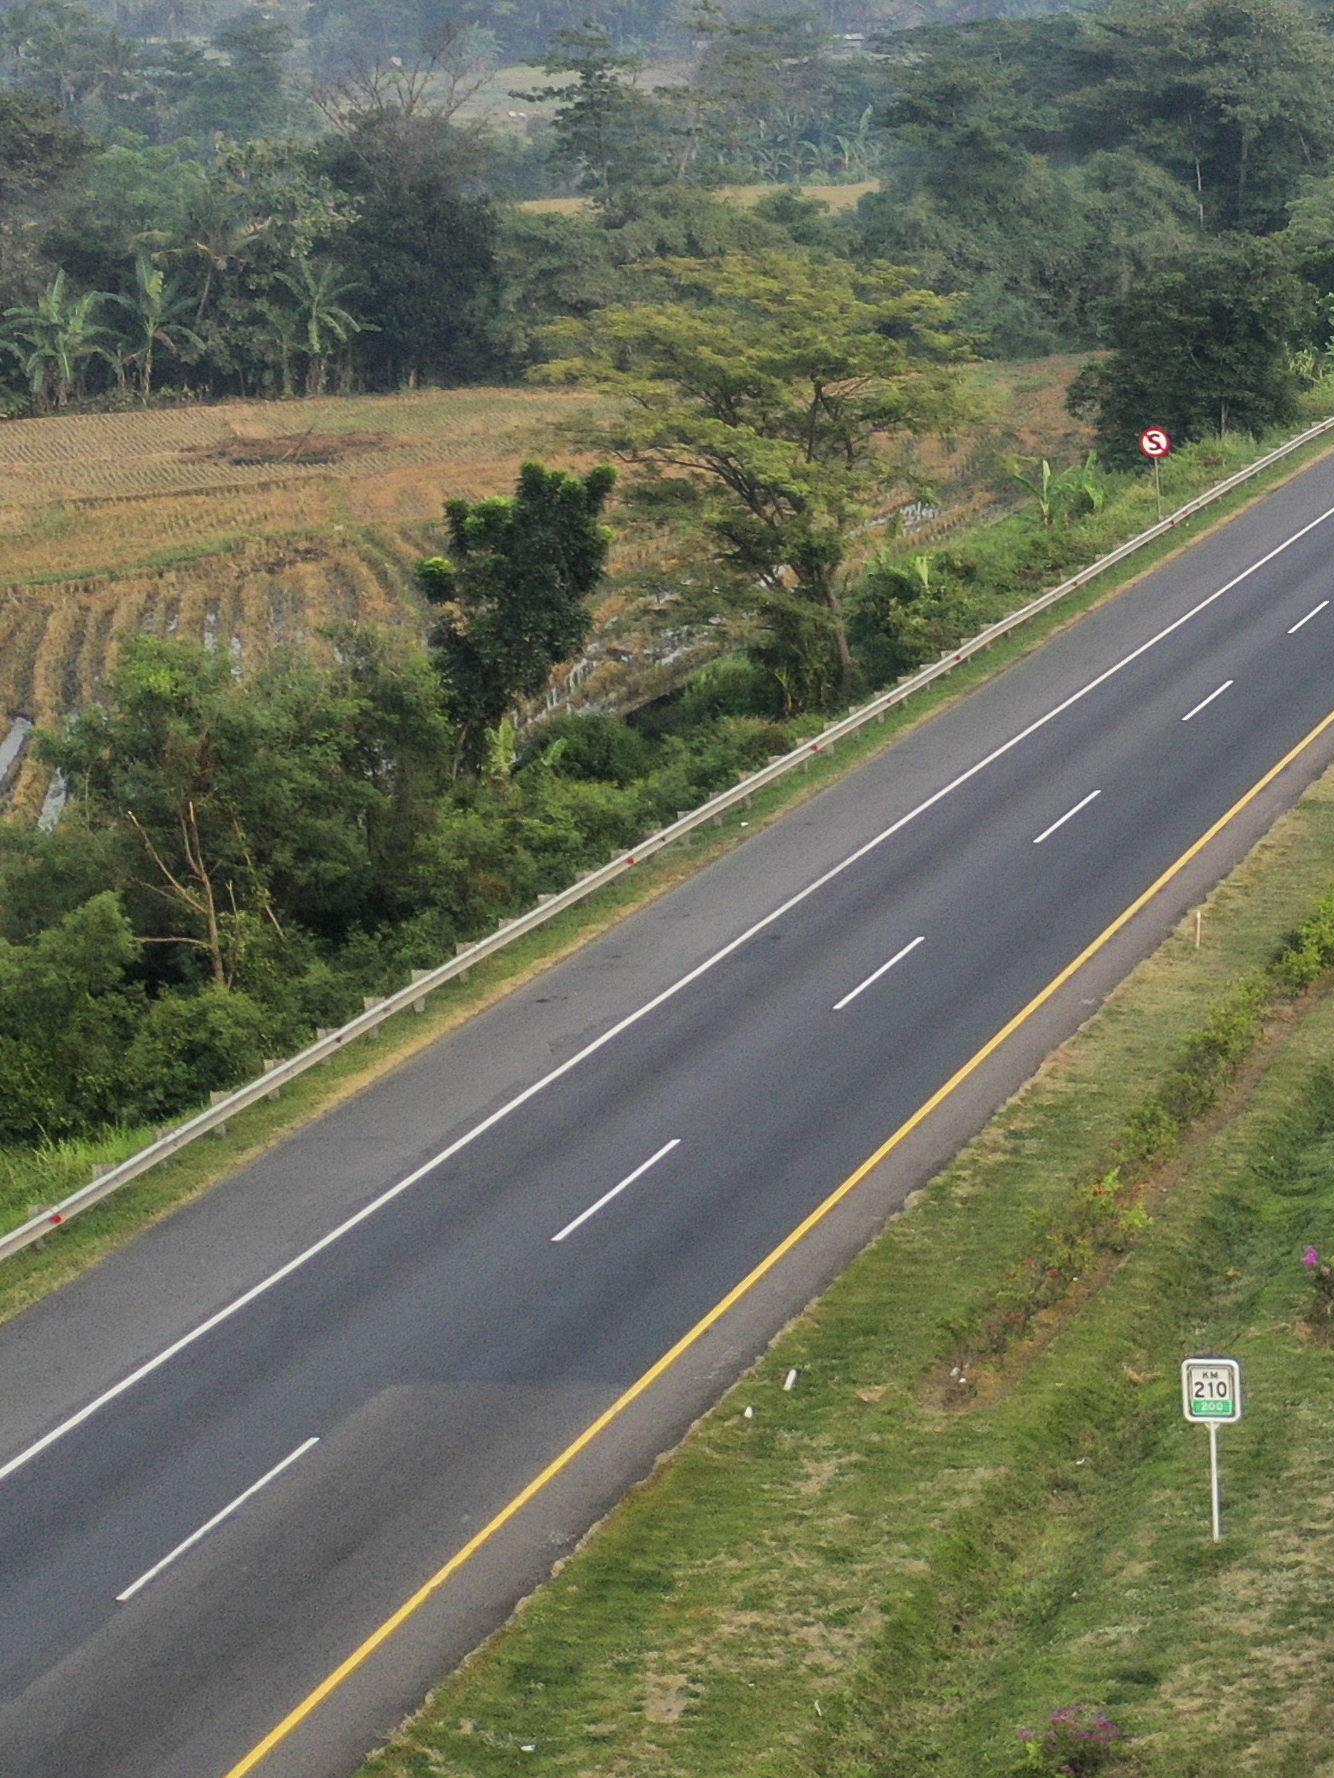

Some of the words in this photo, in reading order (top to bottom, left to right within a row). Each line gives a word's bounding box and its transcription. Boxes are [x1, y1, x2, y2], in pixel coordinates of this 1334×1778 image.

[1202, 1371, 1218, 1379] KM
[1194, 1381, 1227, 1398] 210
[1200, 1402, 1223, 1411] 200
